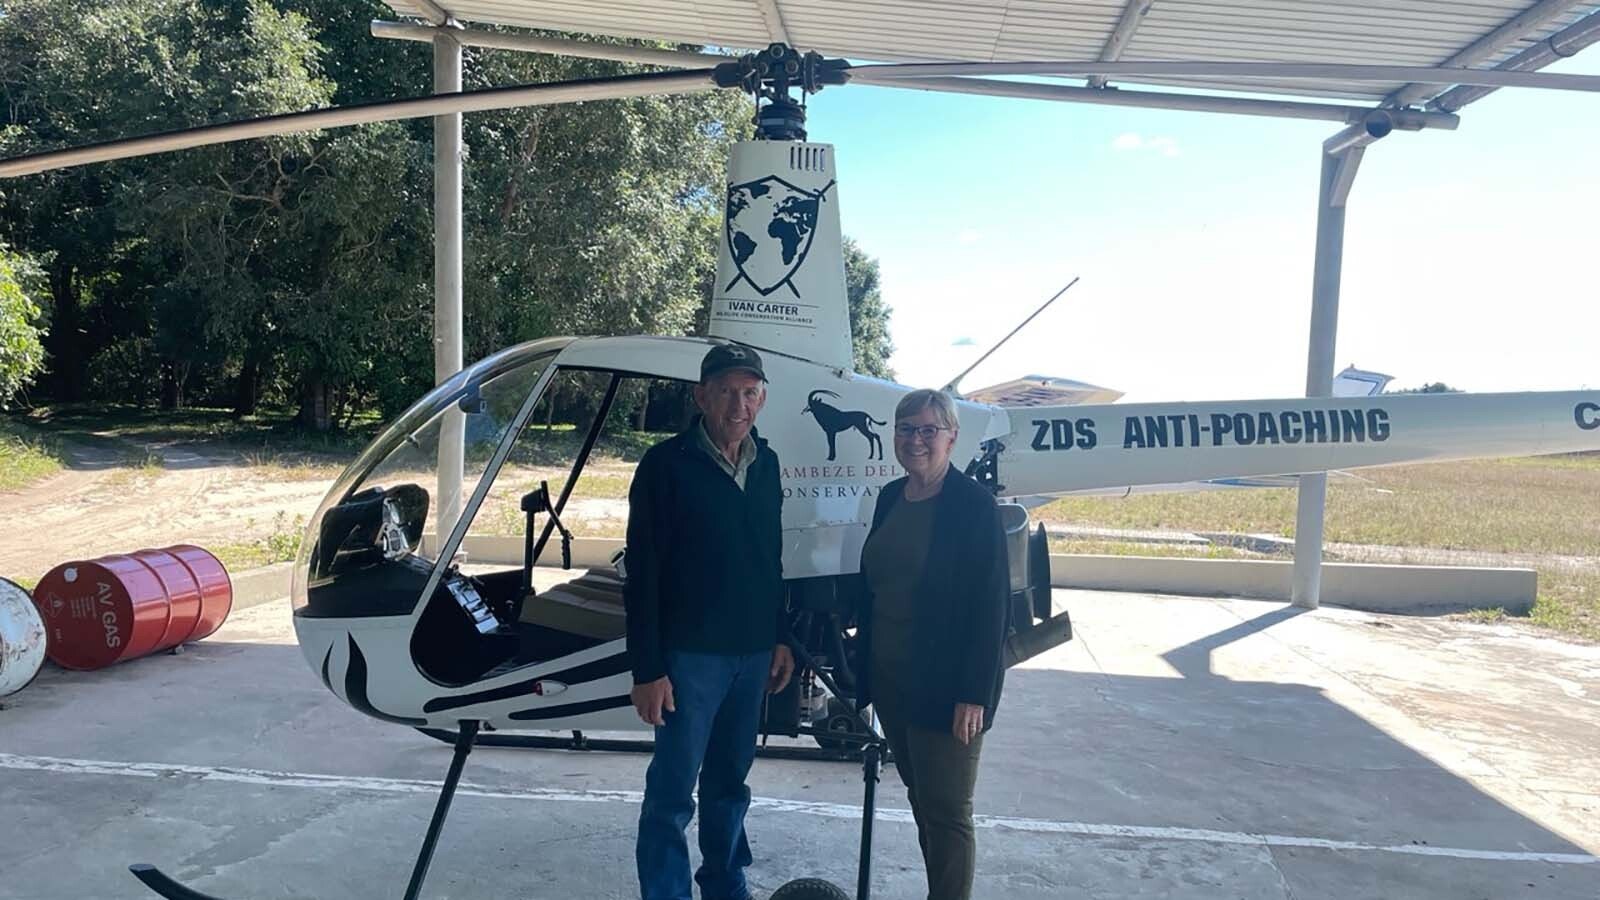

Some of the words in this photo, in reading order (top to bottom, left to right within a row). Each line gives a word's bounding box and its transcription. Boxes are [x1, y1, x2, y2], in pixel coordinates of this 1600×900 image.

[728, 301, 755, 312] IVAN
[757, 303, 799, 316] CARTER
[1031, 418, 1096, 451] ZDS
[1123, 408, 1390, 449] ANTI-POACHING
[780, 466, 856, 479] AMBEZE
[865, 465, 908, 478] DEL
[782, 486, 882, 498] ONSERVAT
[96, 582, 114, 606] AV
[102, 611, 121, 648] GAS
